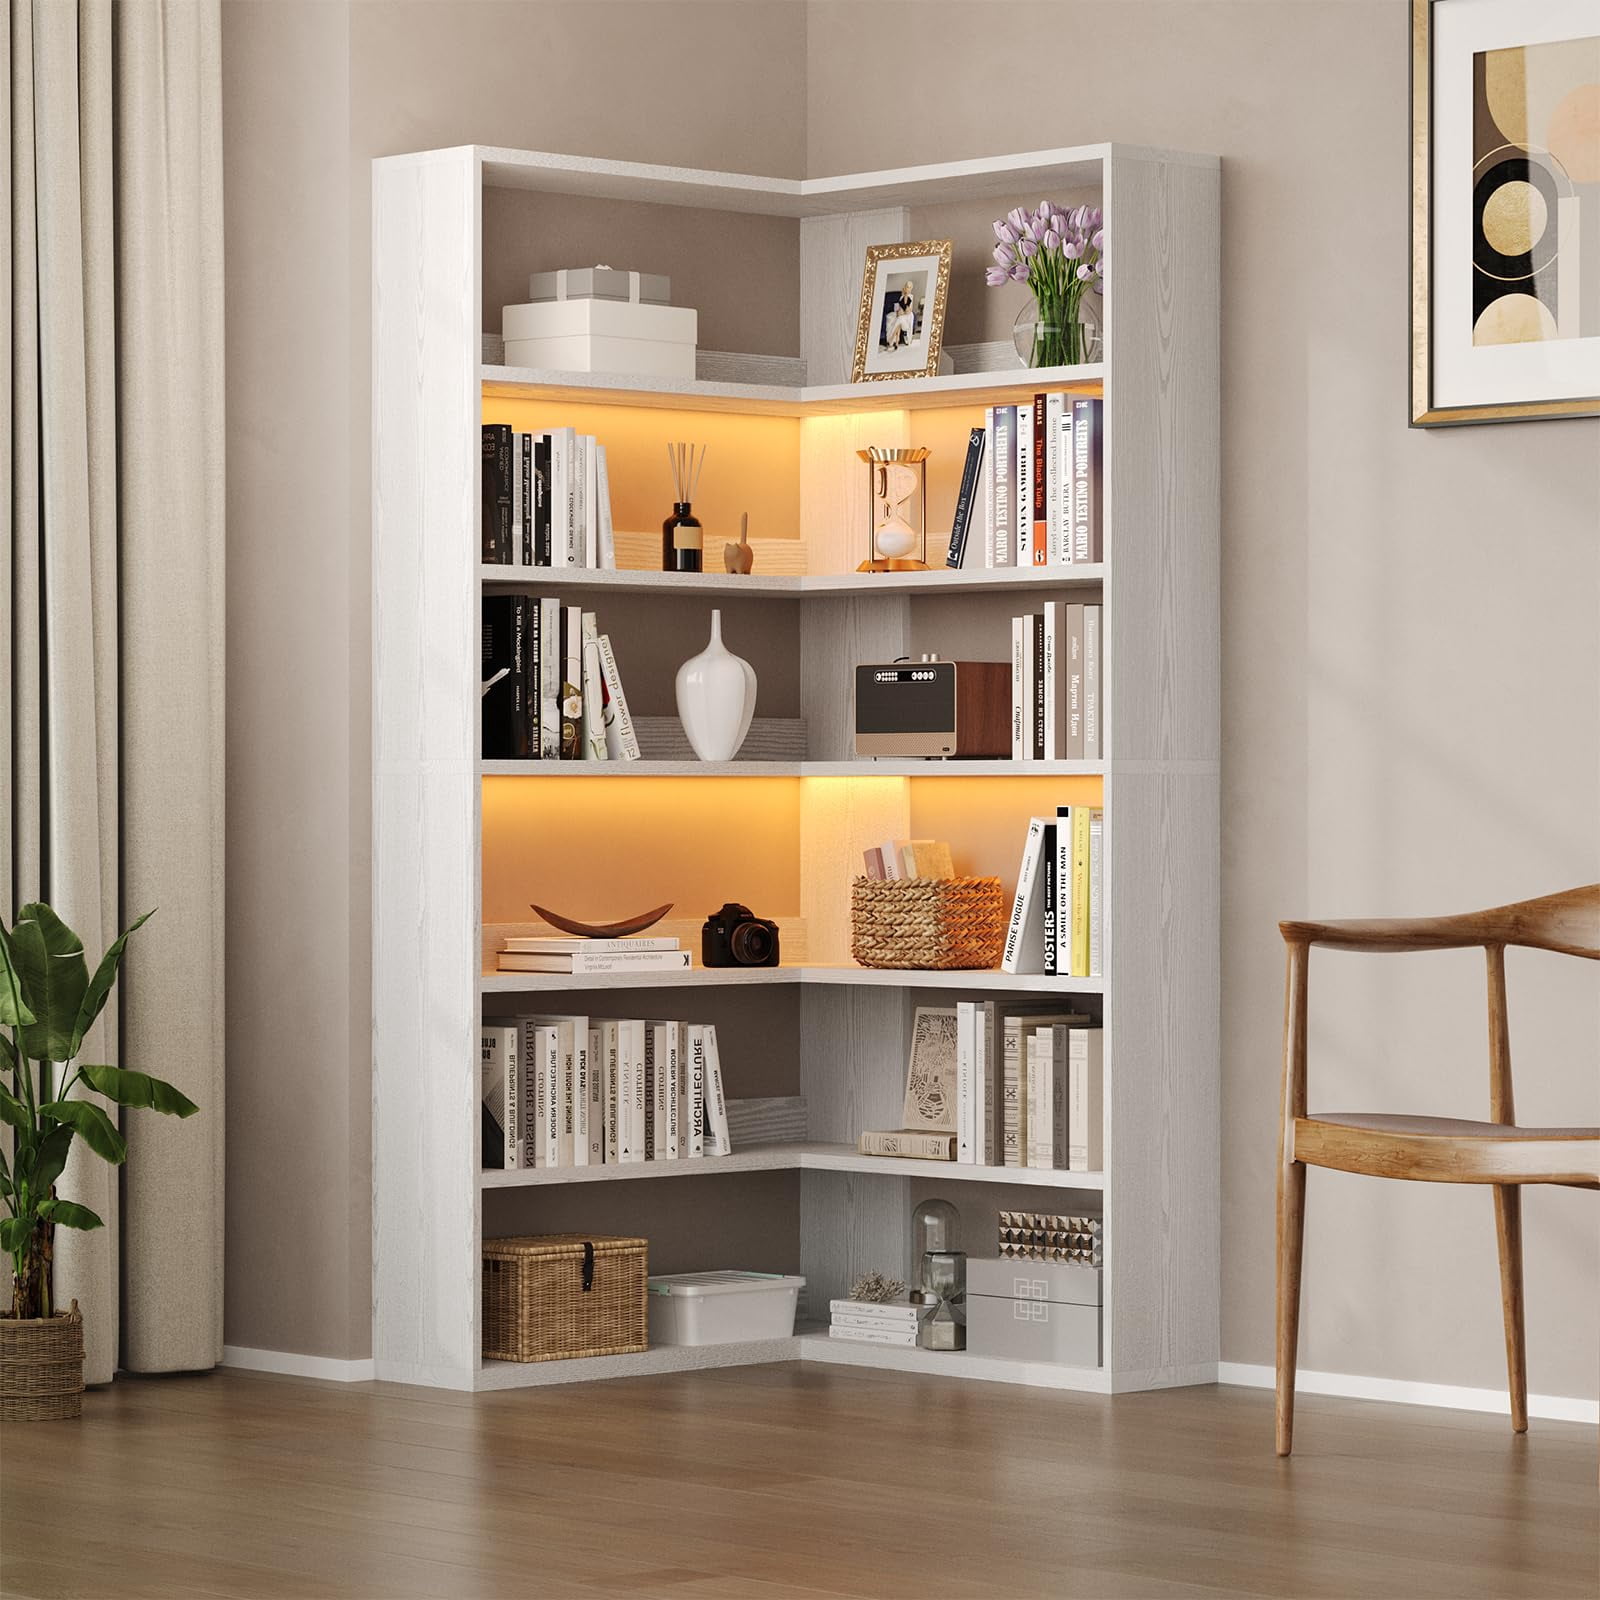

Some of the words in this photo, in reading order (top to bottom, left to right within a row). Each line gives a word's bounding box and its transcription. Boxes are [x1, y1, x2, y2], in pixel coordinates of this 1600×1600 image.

[996, 486, 1007, 527] TESTINO
[1076, 481, 1088, 523] TESTINO
[996, 530, 1007, 563] MARIO
[1076, 526, 1088, 559] MARIO
[600, 638, 618, 690] designer
[1070, 674, 1079, 709] Мартин
[615, 696, 630, 736] flower
[1070, 714, 1079, 736] Иден
[1060, 894, 1066, 907] ON
[1005, 928, 1018, 962] PARISE
[1012, 894, 1025, 926] VOGUE
[1045, 911, 1054, 970] POSTERS
